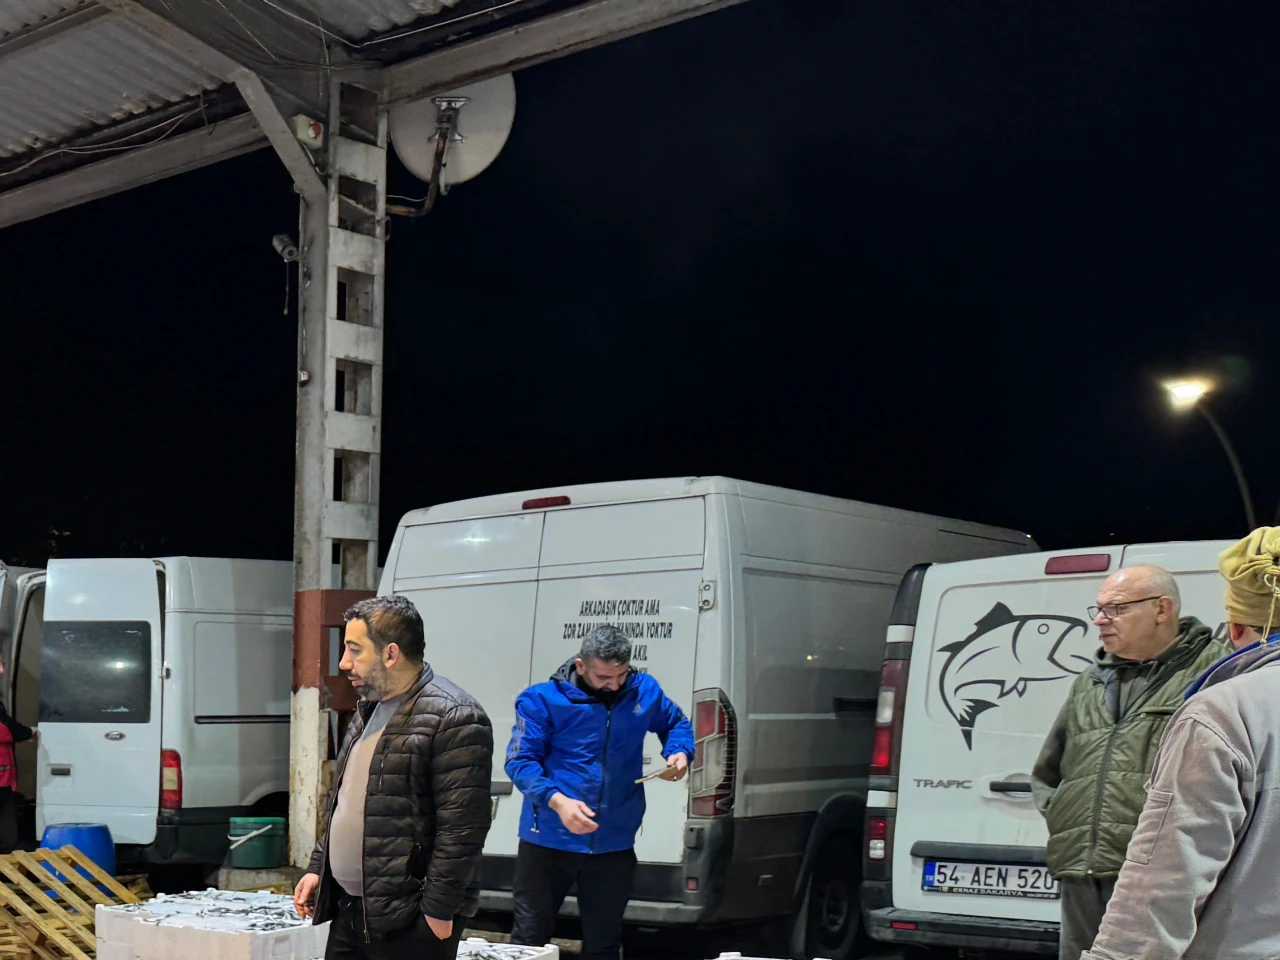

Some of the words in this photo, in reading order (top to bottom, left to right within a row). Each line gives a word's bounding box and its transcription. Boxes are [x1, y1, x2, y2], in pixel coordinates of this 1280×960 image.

[579, 600, 617, 620] ARKADAŞIN
[617, 600, 644, 620] ÇOKTUR
[644, 600, 660, 616] AMA
[563, 623, 577, 639] ZOR
[646, 622, 673, 638] YOKTUR
[913, 779, 972, 789] TRAFIC
[936, 864, 960, 885] 54
[970, 866, 1009, 888] AEN
[1017, 868, 1054, 890] 520
